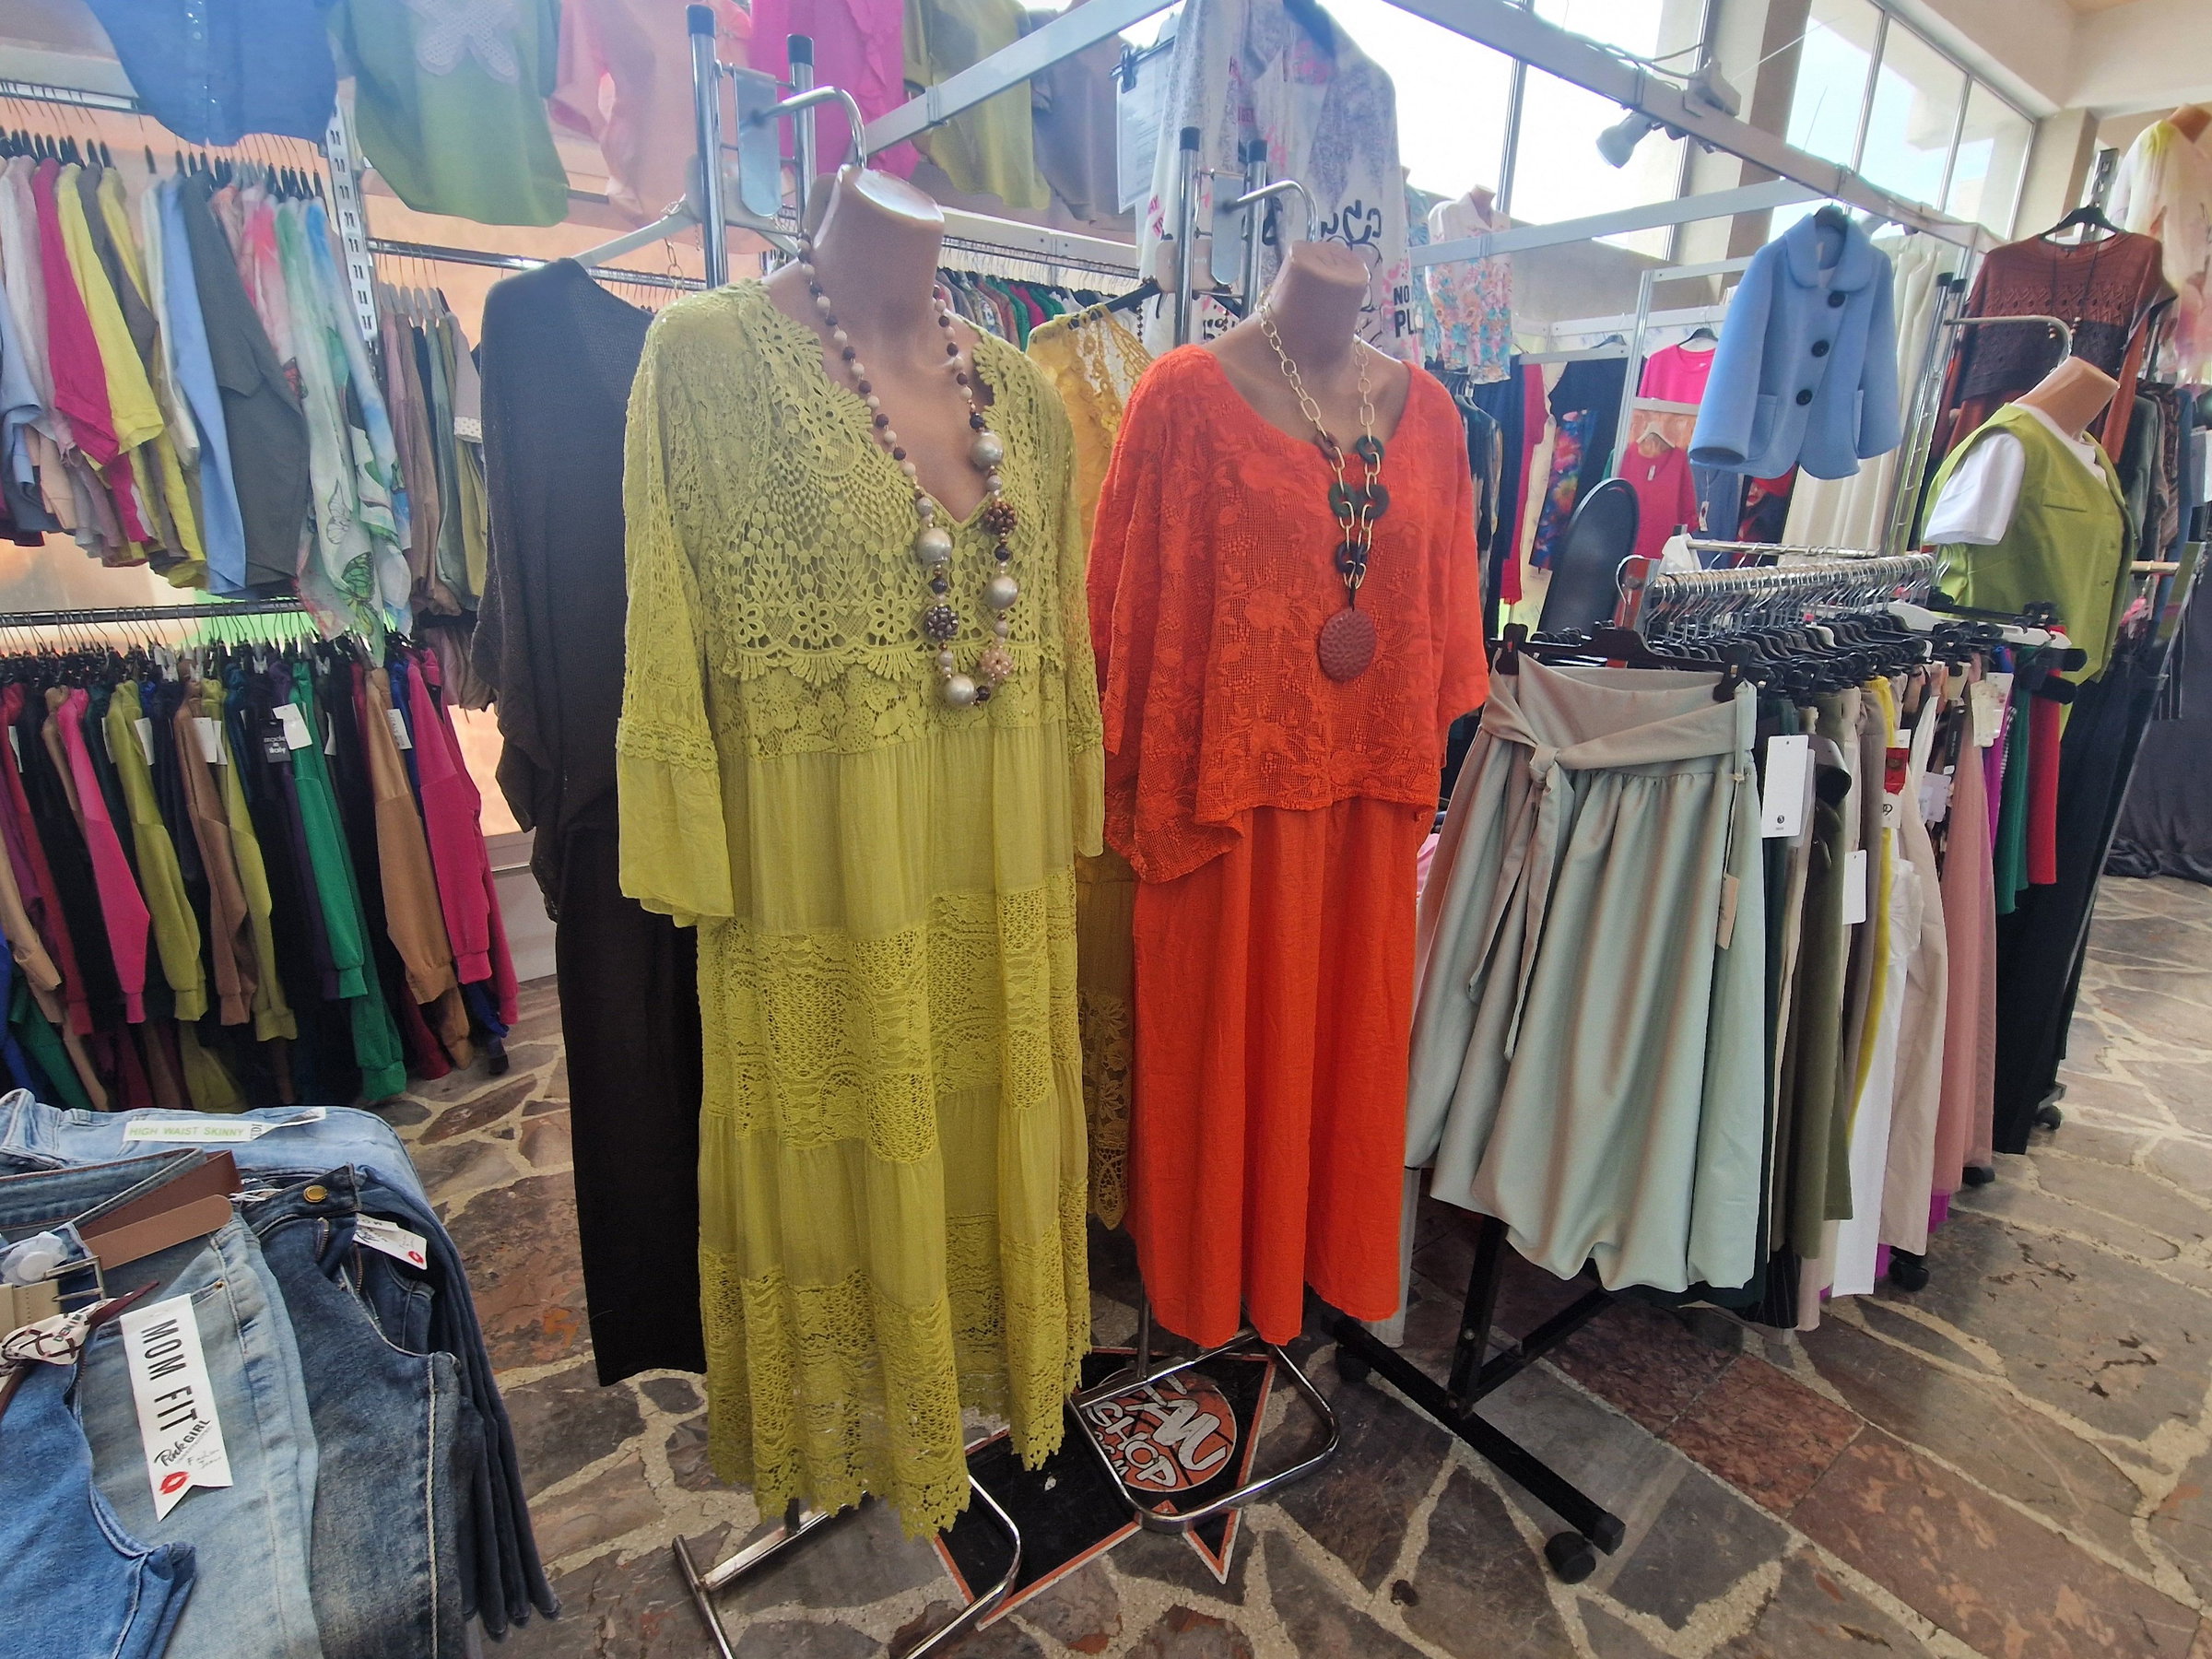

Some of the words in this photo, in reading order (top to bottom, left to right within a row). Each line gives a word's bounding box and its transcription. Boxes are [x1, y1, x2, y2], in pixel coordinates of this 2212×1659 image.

[1394, 285, 1410, 306] NO
[129, 1127, 158, 1136] HIGH
[163, 1126, 199, 1136] WAIST
[203, 1126, 243, 1136] SKINNY
[141, 1318, 186, 1381] MOM
[154, 1385, 198, 1431] FIT
[182, 1418, 211, 1444] GIRL
[1086, 1400, 1178, 1488] SHOP
